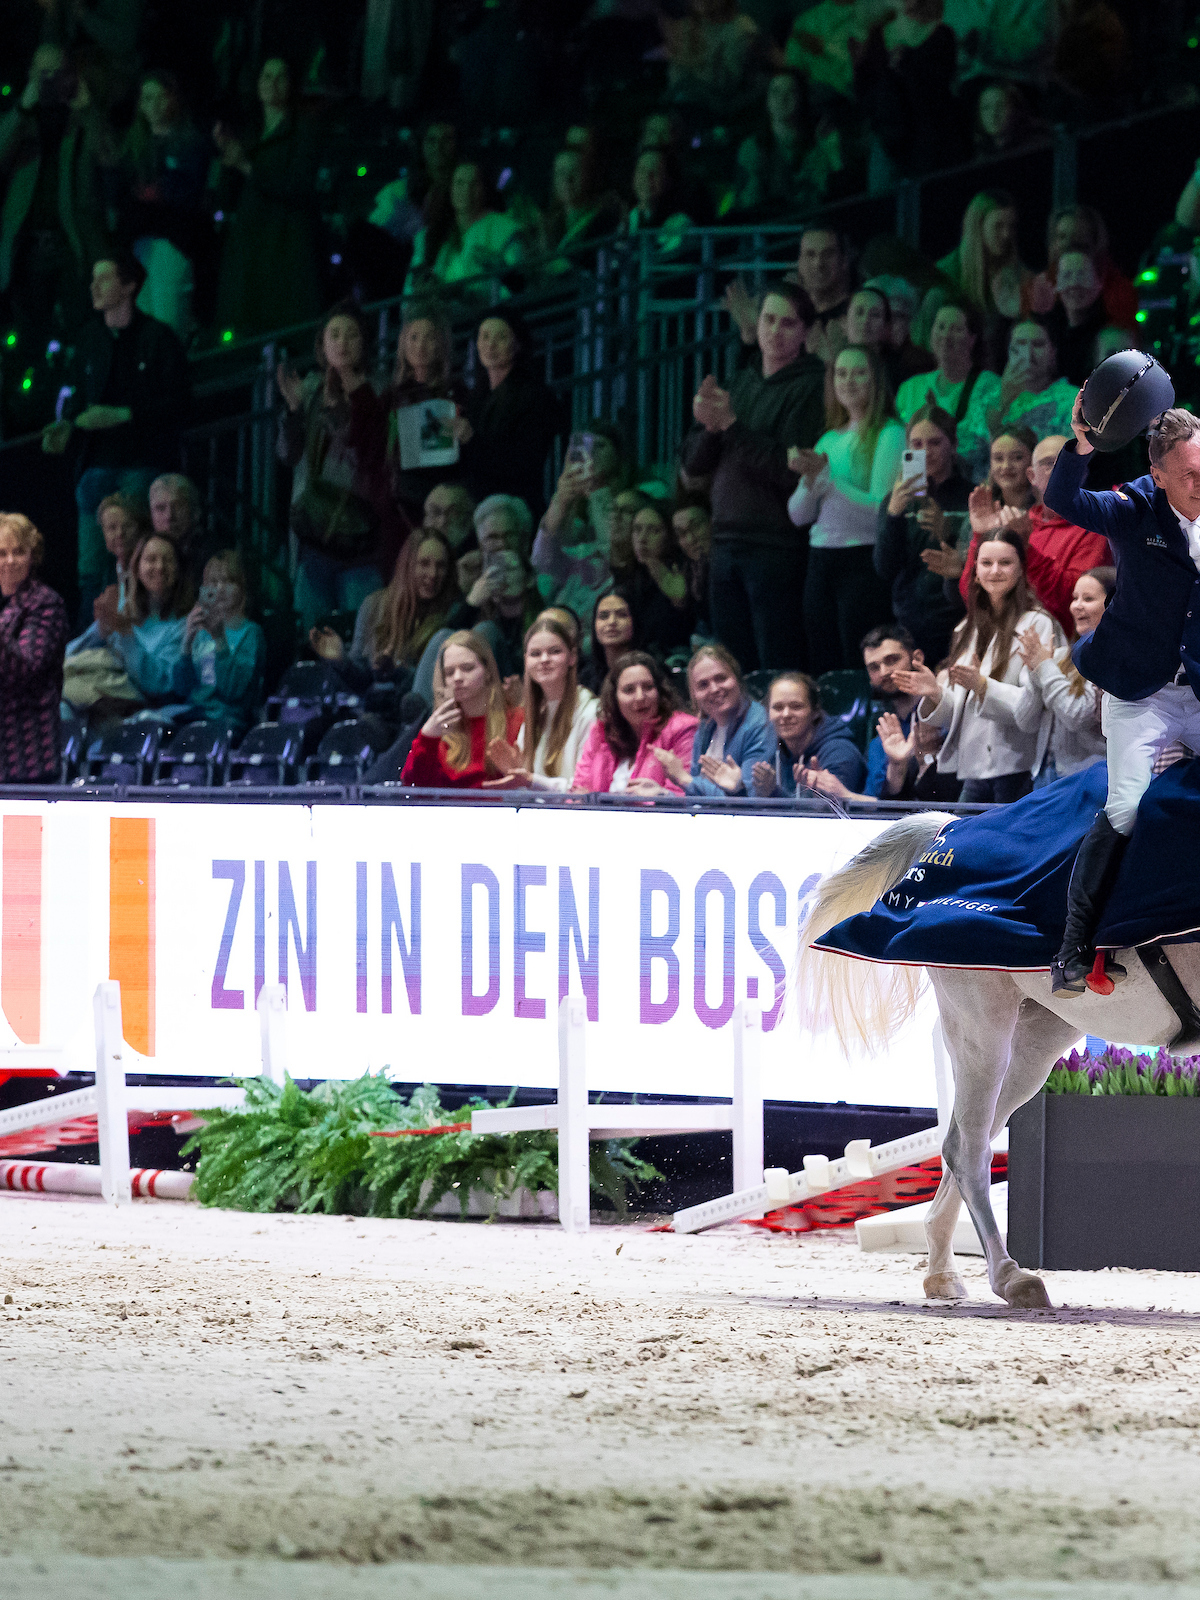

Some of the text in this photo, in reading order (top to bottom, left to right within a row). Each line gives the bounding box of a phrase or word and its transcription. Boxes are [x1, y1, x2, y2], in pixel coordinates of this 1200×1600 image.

[918, 848, 955, 867] utch
[880, 891, 914, 909] MY
[211, 860, 823, 1032] ZIN IN DEN BOS
